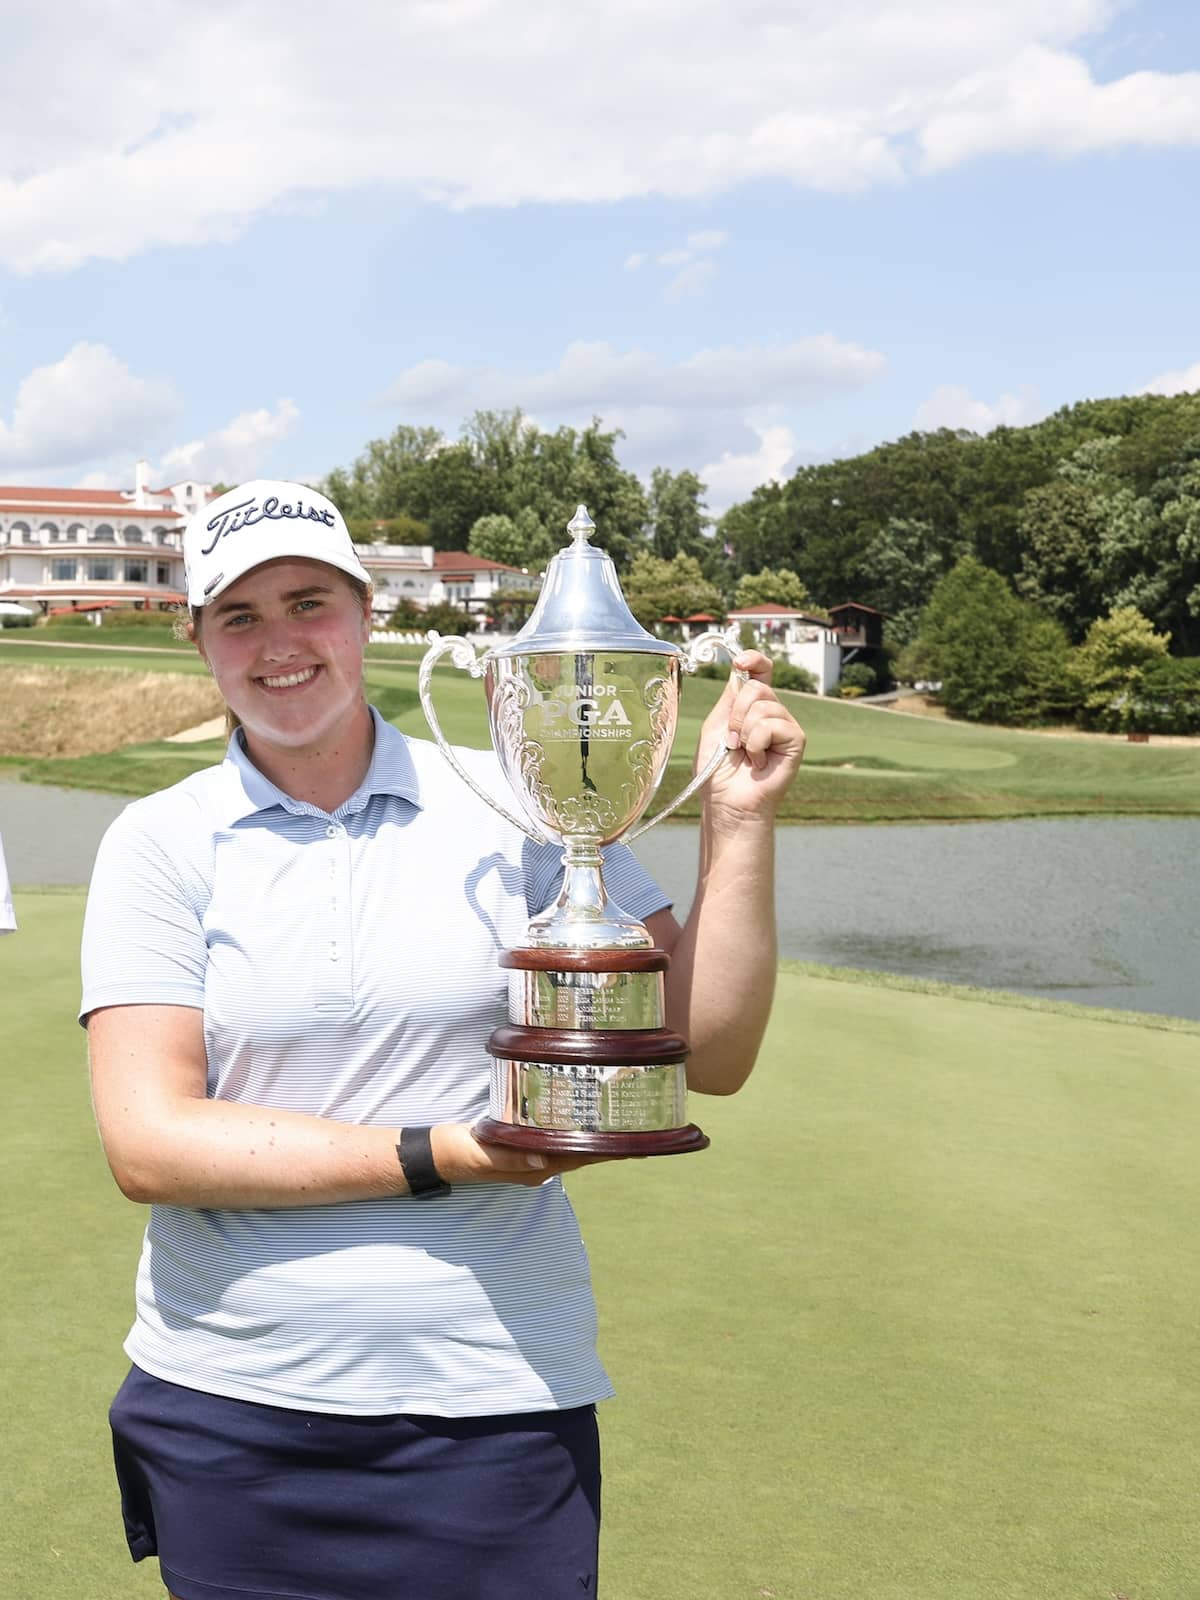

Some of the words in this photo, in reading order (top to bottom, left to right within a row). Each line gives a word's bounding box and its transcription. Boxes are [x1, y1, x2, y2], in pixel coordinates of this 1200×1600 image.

[201, 496, 336, 555] Titleist
[554, 685, 617, 697] JUNIOR
[540, 698, 632, 726] PGA
